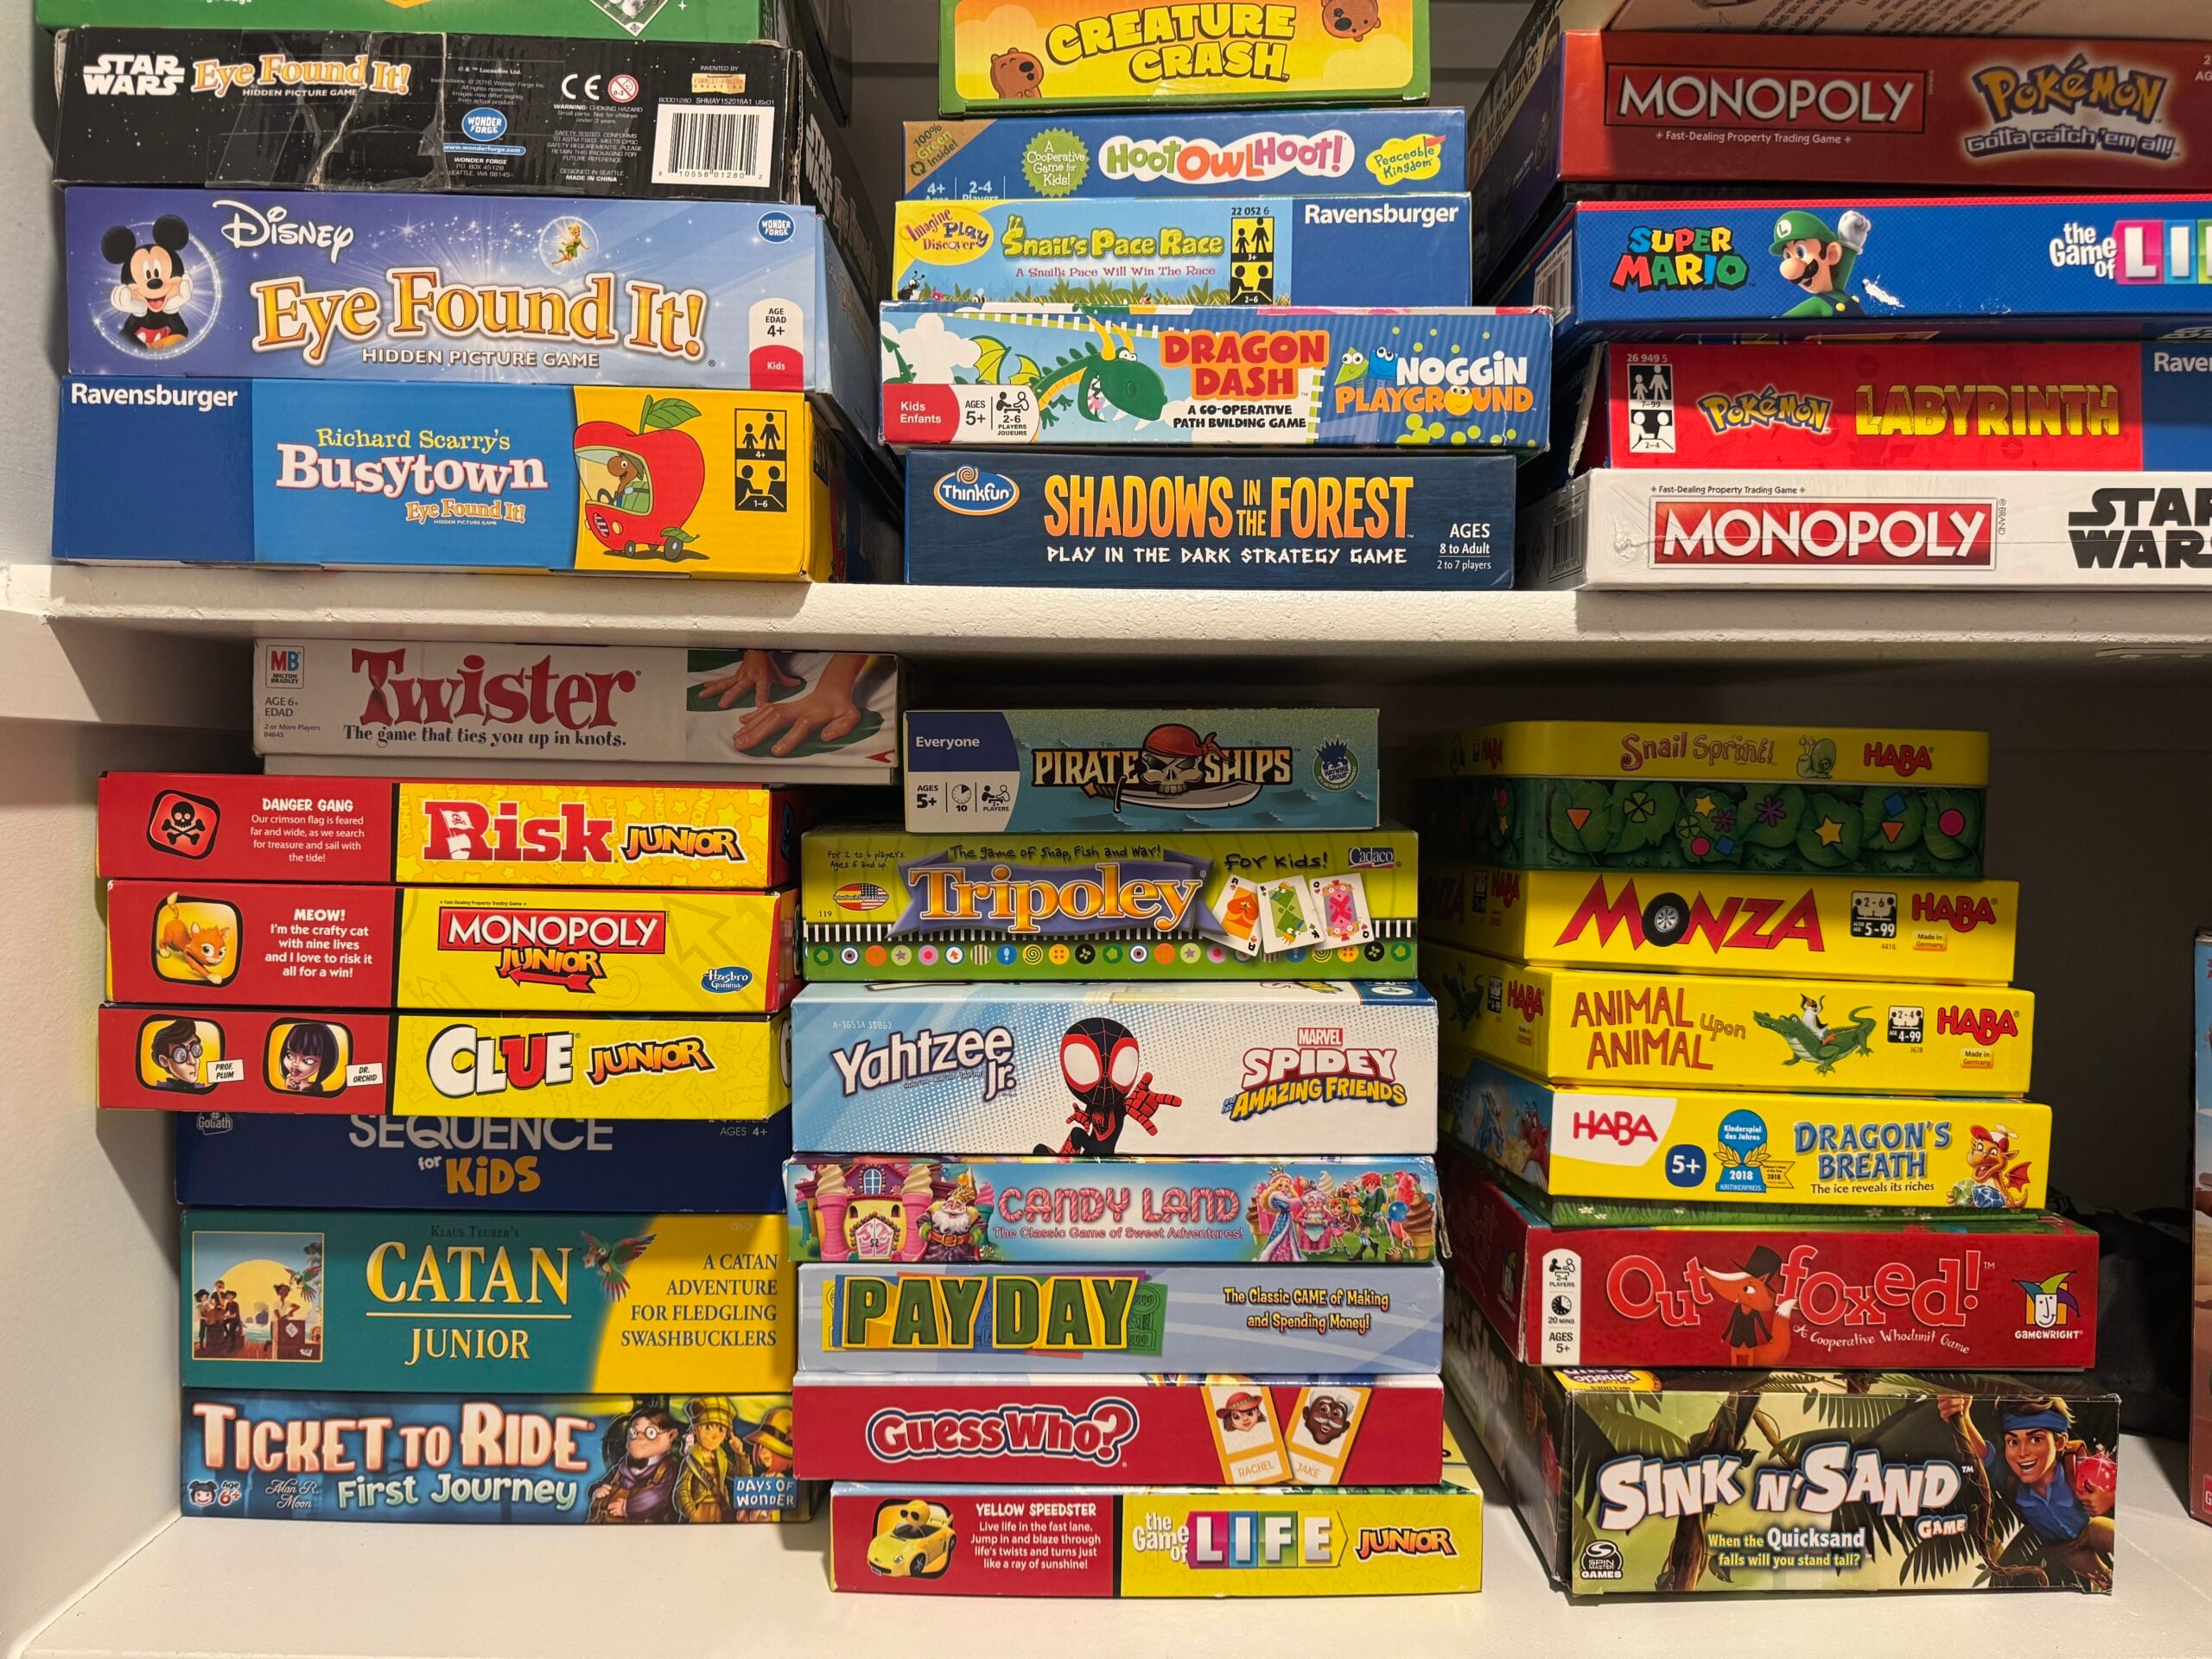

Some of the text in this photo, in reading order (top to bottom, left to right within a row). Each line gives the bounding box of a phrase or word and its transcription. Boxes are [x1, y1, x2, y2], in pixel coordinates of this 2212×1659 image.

[1046, 3, 1296, 65] CREATURE
[83, 54, 185, 75] STAR
[191, 54, 412, 98] Eye Found It!
[1128, 41, 1290, 83] CRASH
[83, 73, 184, 96] WARS
[285, 89, 327, 98] PICTURE
[1618, 73, 1914, 123] MONOPOLY
[467, 116, 503, 128] WONDER
[469, 124, 499, 135] FORGE
[1666, 130, 1841, 145] Fast-Dealing Property Trading Game
[1027, 151, 1085, 164] Cooperative
[1044, 141, 1054, 152] A
[1374, 143, 1434, 168] Peaceable
[1033, 162, 1077, 174] Game for
[1043, 174, 1071, 187] Kids!
[1382, 158, 1433, 179] Kingdom
[1305, 203, 1459, 227] Ravensburger
[1001, 215, 1225, 259] Snail's Pace Race
[1629, 226, 1733, 253] SUPER
[1015, 265, 1216, 277] A Snail's Pace Will Win The Race
[1610, 253, 1750, 292] MARIO
[251, 266, 709, 366] Eye Found It!
[765, 315, 787, 324] EDAD
[767, 308, 785, 316] AGE
[766, 325, 785, 338] 4+
[361, 348, 600, 368] HIDDEN PICTURE GAME
[1163, 333, 1327, 365] DRAGON
[766, 361, 786, 372] Kids
[1194, 367, 1295, 397] DASH
[71, 383, 238, 412] Ravensburger
[1854, 385, 2120, 436] LABYRINTH
[315, 428, 511, 454] Richard Scarry's
[276, 443, 550, 499] Busytown
[1044, 474, 1414, 538] SHADOWS IN THE FOREST
[1662, 508, 1986, 558] MONOPOLY
[1046, 546, 1408, 564] PLAY IN THE DARK STRATEGY GAME
[351, 647, 637, 732] Twister
[344, 723, 627, 749] The game that ties you up in knots.
[1620, 731, 1777, 772] Snail Sprint!
[1034, 749, 1292, 785] PIRATE SHIPS
[1863, 742, 1933, 777] HABA
[262, 798, 353, 812] DANGER GANG
[423, 800, 748, 863] Risk JUNIOR
[908, 862, 1203, 933] Tripoley
[294, 908, 346, 922] MEOW!
[1553, 874, 1825, 954] MONZA
[448, 913, 658, 948] MONOPOLY
[497, 947, 608, 979] JUNIOR
[1571, 987, 1746, 1041] ANIMAL Upon
[1937, 1006, 2018, 1046] HABA
[1298, 1027, 1343, 1046] MARVEL
[1586, 1028, 1713, 1071] ANIMAL
[427, 1024, 716, 1098] CLUE JUNIOR
[830, 1026, 1015, 1096] Yahtzee
[1242, 1048, 1398, 1090] SPIDEY
[984, 1058, 1017, 1102] Jr.
[1230, 1077, 1408, 1122] AMAZING FRIENDS
[349, 1115, 613, 1151] SEQUENCE
[1573, 1109, 1658, 1146] HABA
[1794, 1121, 1951, 1154] DRAGON'S
[418, 1154, 442, 1171] for
[1818, 1152, 1928, 1181] BREATH
[1811, 1182, 1935, 1194] The ice reveals its riches
[998, 1188, 1240, 1223] CANDY LAND
[365, 1241, 574, 1305] CATAN
[1606, 1244, 1982, 1327] Out foxed!
[404, 1327, 530, 1367] JUNIOR
[621, 1330, 777, 1347] SWASHBUCKLERS
[192, 1402, 591, 1473] TICKET TO RIDE
[871, 1402, 1135, 1461] Guess Who?
[338, 1473, 577, 1511] First Journey
[1598, 1455, 1745, 1530] SINK
[1800, 1441, 1961, 1516] SAND
[976, 1503, 1096, 1517] YELLOW SPEEDSTER
[1145, 1512, 1172, 1531] the
[1132, 1524, 1189, 1553] Game
[1196, 1516, 1331, 1562] LIFE
[1708, 1528, 1866, 1549] When the Quicksand
[1916, 1515, 1967, 1539] GAME
[1171, 1544, 1188, 1563] of
[1357, 1526, 1458, 1561] JUNIOR
